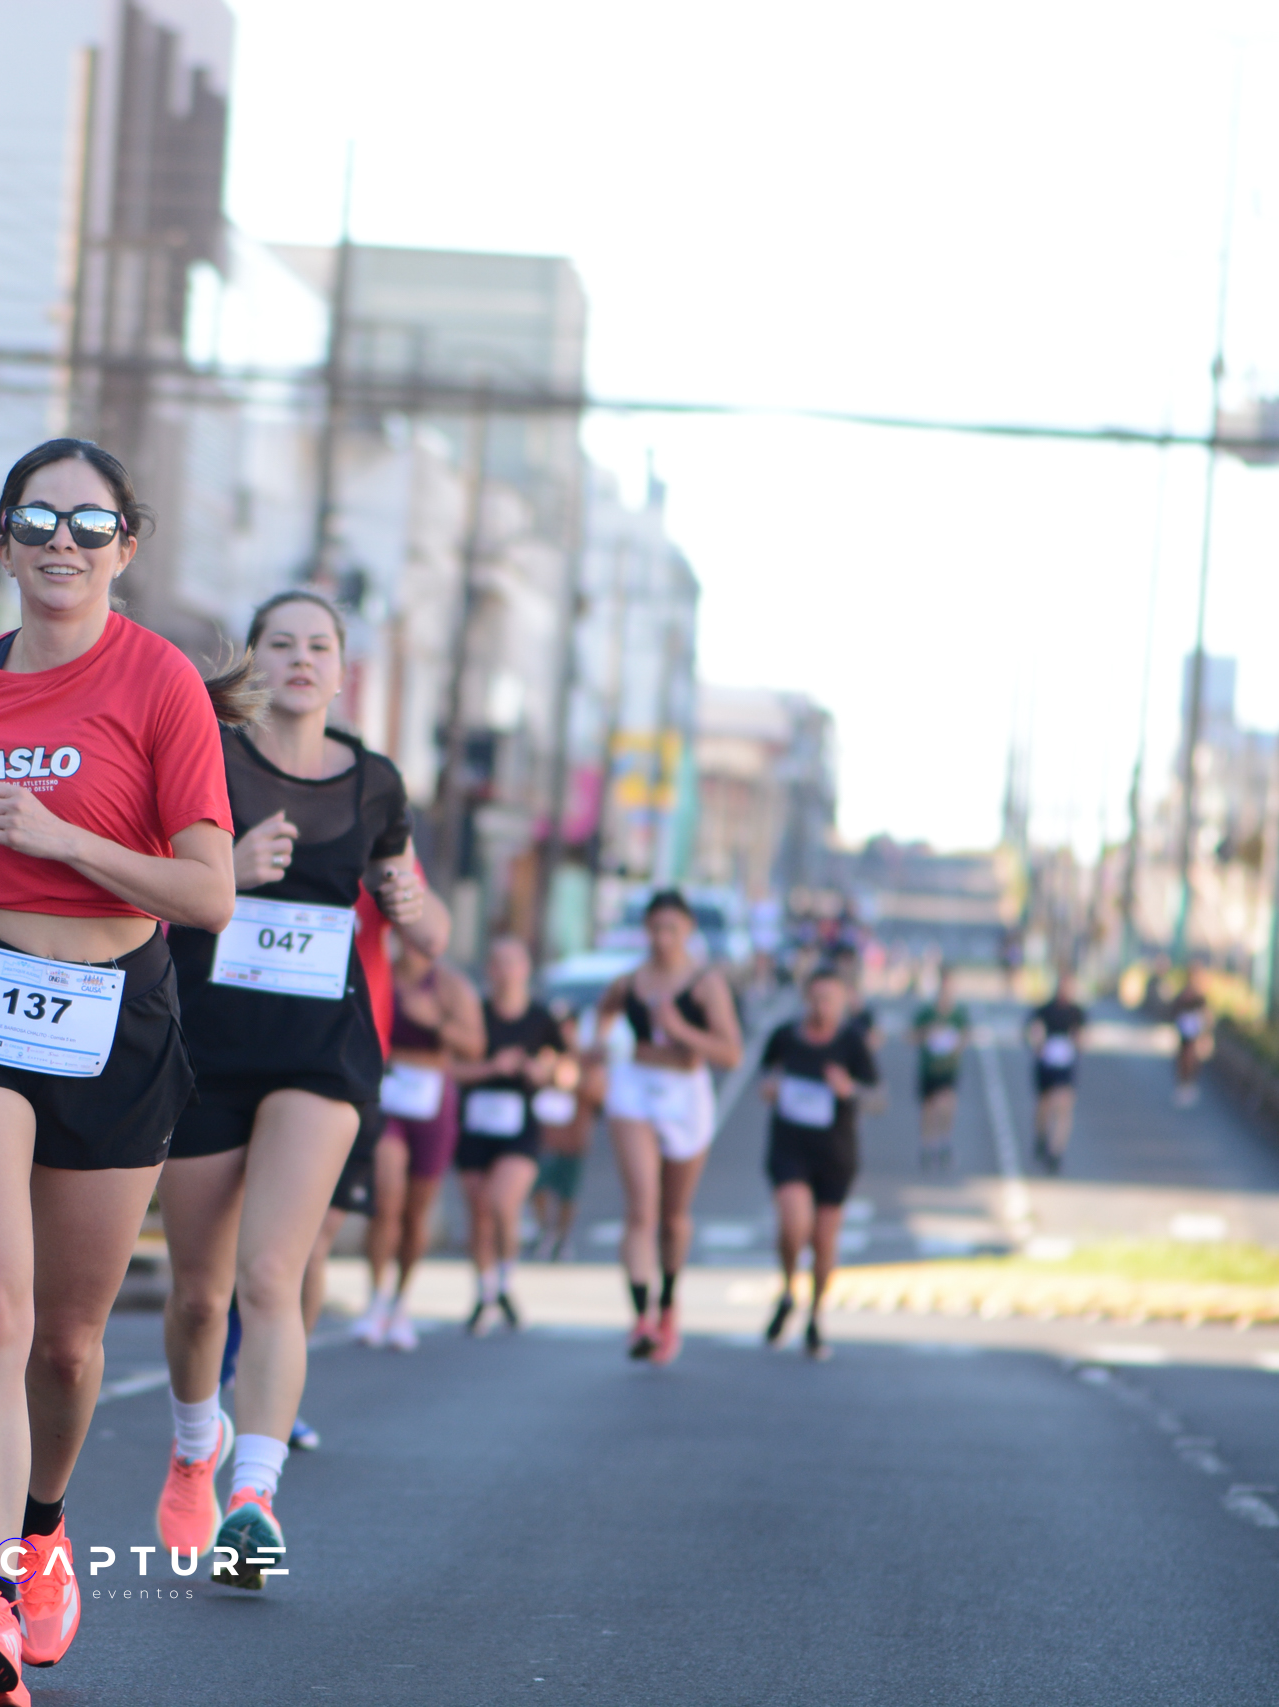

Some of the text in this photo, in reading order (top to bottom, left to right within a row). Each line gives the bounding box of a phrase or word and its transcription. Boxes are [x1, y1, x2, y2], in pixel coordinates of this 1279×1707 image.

[23, 779, 59, 787] ATLETISMO
[258, 928, 313, 954] 047
[81, 985, 102, 994] CAUSA
[3, 987, 73, 1024] 137
[4, 1025, 26, 1033] BARBOSA
